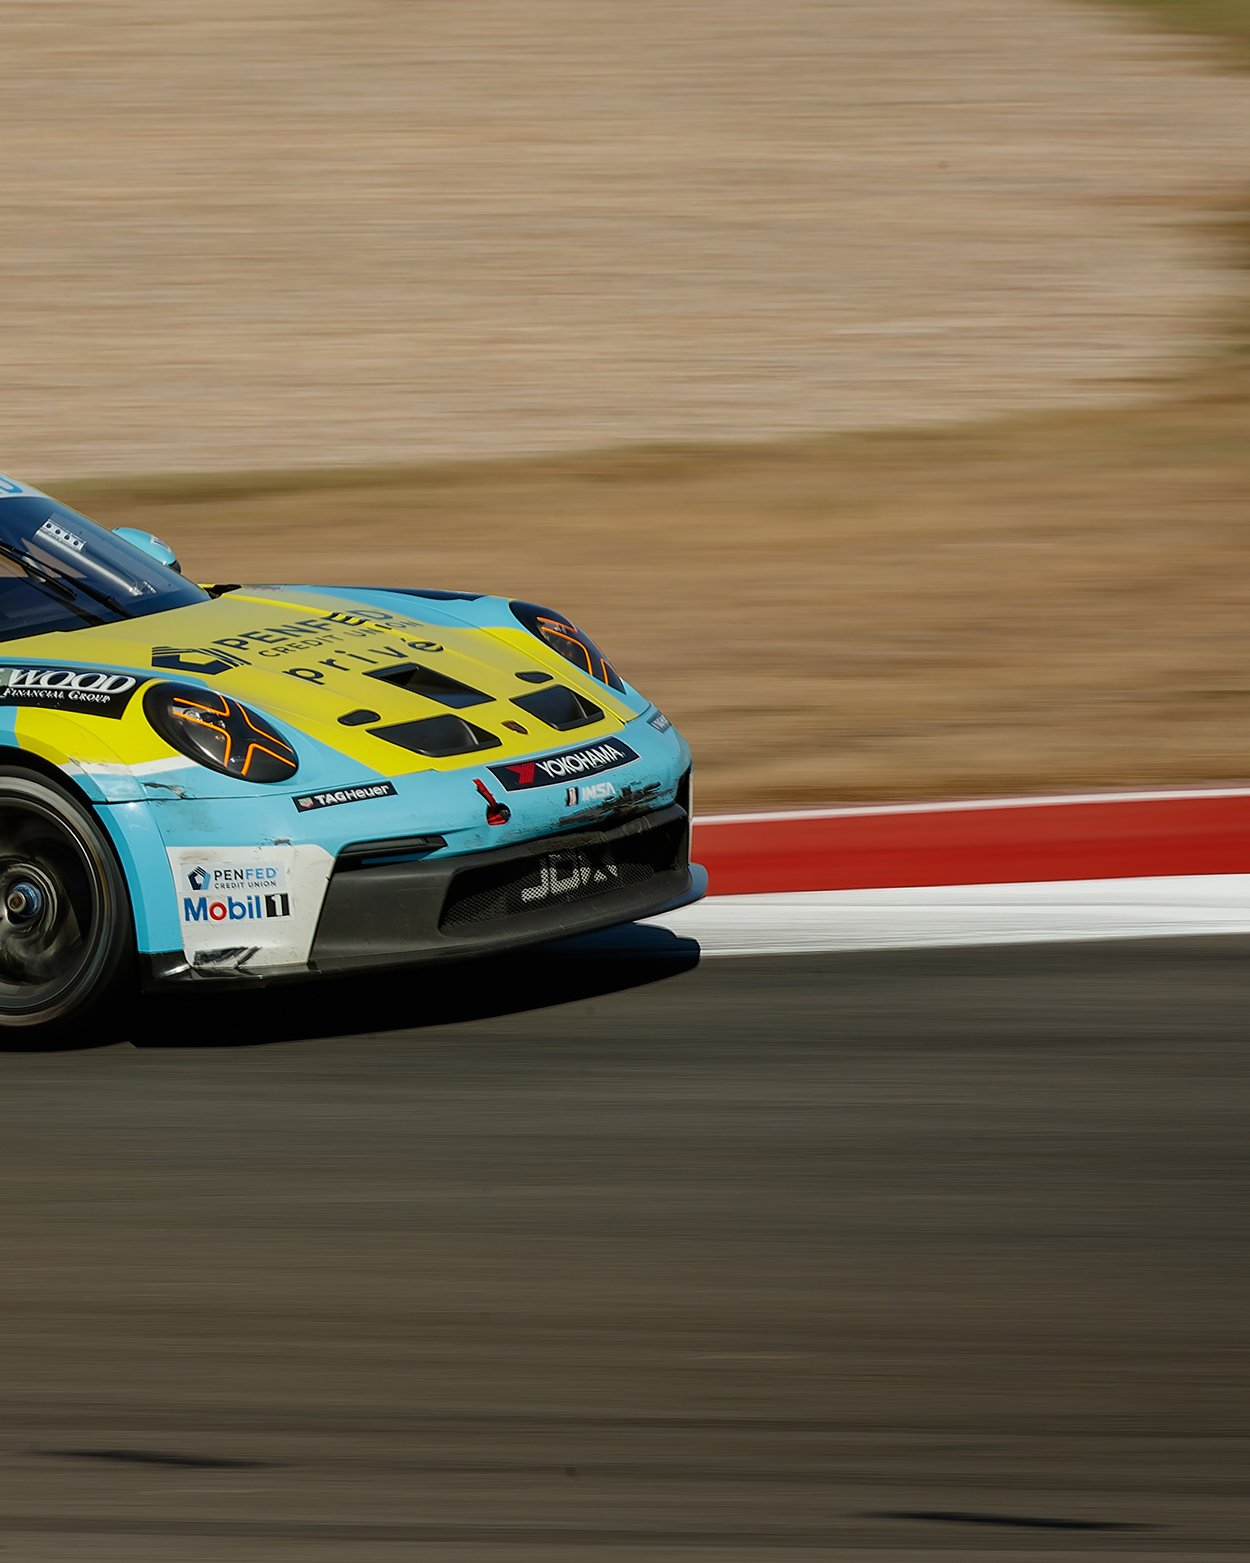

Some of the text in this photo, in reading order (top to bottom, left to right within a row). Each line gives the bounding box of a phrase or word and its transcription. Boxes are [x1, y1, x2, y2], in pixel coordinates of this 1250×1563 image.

[211, 609, 394, 651] PENFED
[259, 619, 425, 658] CREDIT UNION
[282, 637, 445, 686] privé
[3, 688, 111, 704] FINANCIAL GROUP
[8, 669, 137, 695] WOOD
[535, 743, 626, 779] YOKOHAMA
[581, 782, 617, 802] IMSA
[213, 867, 277, 881] PENFED
[214, 880, 277, 890] CREDIT UNION
[183, 892, 291, 922] Mobil 1
